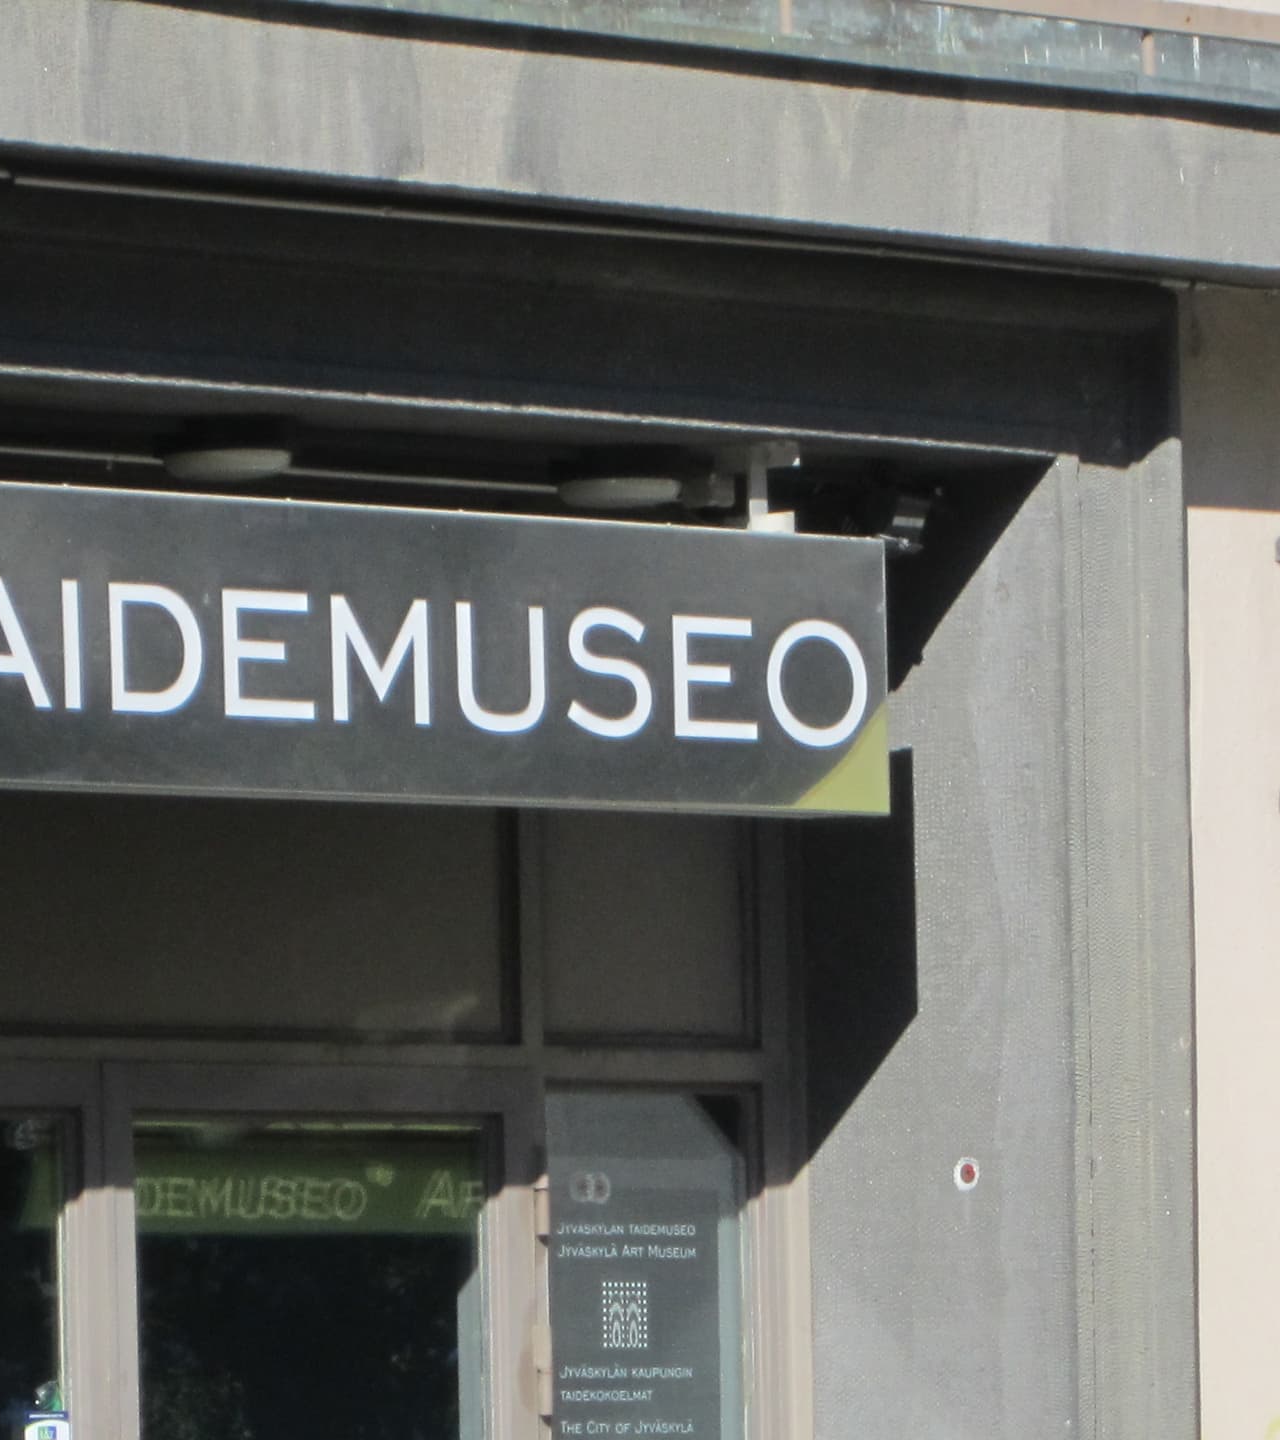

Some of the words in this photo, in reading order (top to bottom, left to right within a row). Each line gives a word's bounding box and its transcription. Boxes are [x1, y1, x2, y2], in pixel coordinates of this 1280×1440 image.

[628, 1223, 697, 1237] TAIDEMUSEO
[621, 1244, 645, 1258] ART
[647, 1244, 697, 1259] MUSEUM
[631, 1366, 694, 1379] KAUPUNGIN
[560, 1389, 654, 1401] TAIDEKOKOELMAT
[560, 1420, 583, 1434] THE
[586, 1420, 611, 1434] CITY
[615, 1422, 632, 1434] OF
